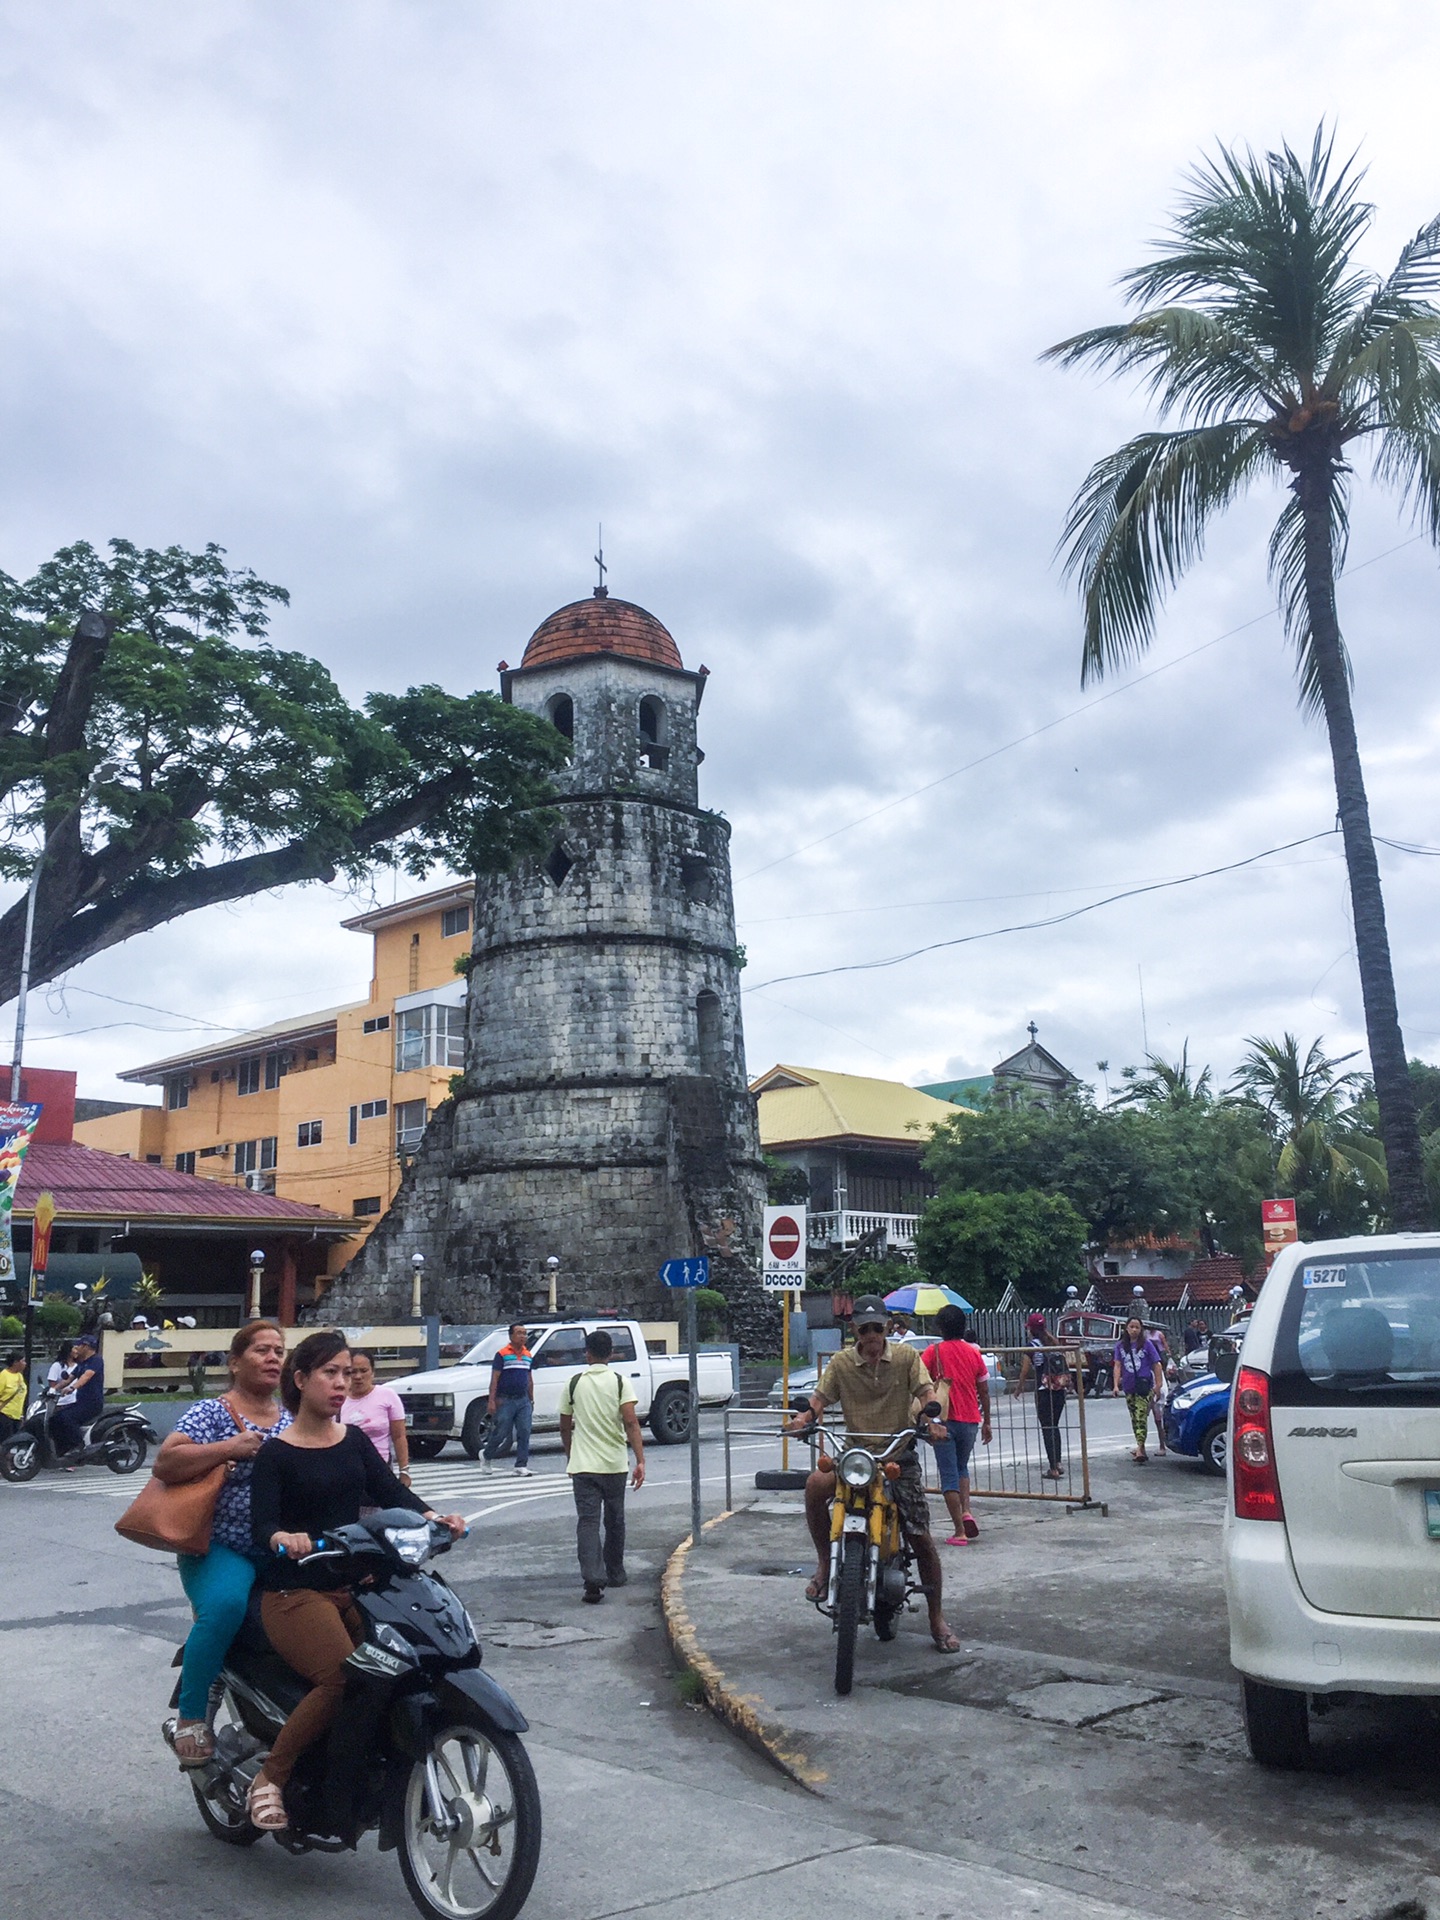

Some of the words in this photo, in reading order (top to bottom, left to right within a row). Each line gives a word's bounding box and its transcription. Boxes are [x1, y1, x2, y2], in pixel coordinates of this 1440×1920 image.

[765, 1274, 802, 1287] DCCCO
[1312, 1268, 1346, 1283] 5270
[1287, 1427, 1358, 1438] AVANZA
[365, 1645, 400, 1669] SUZUKI
